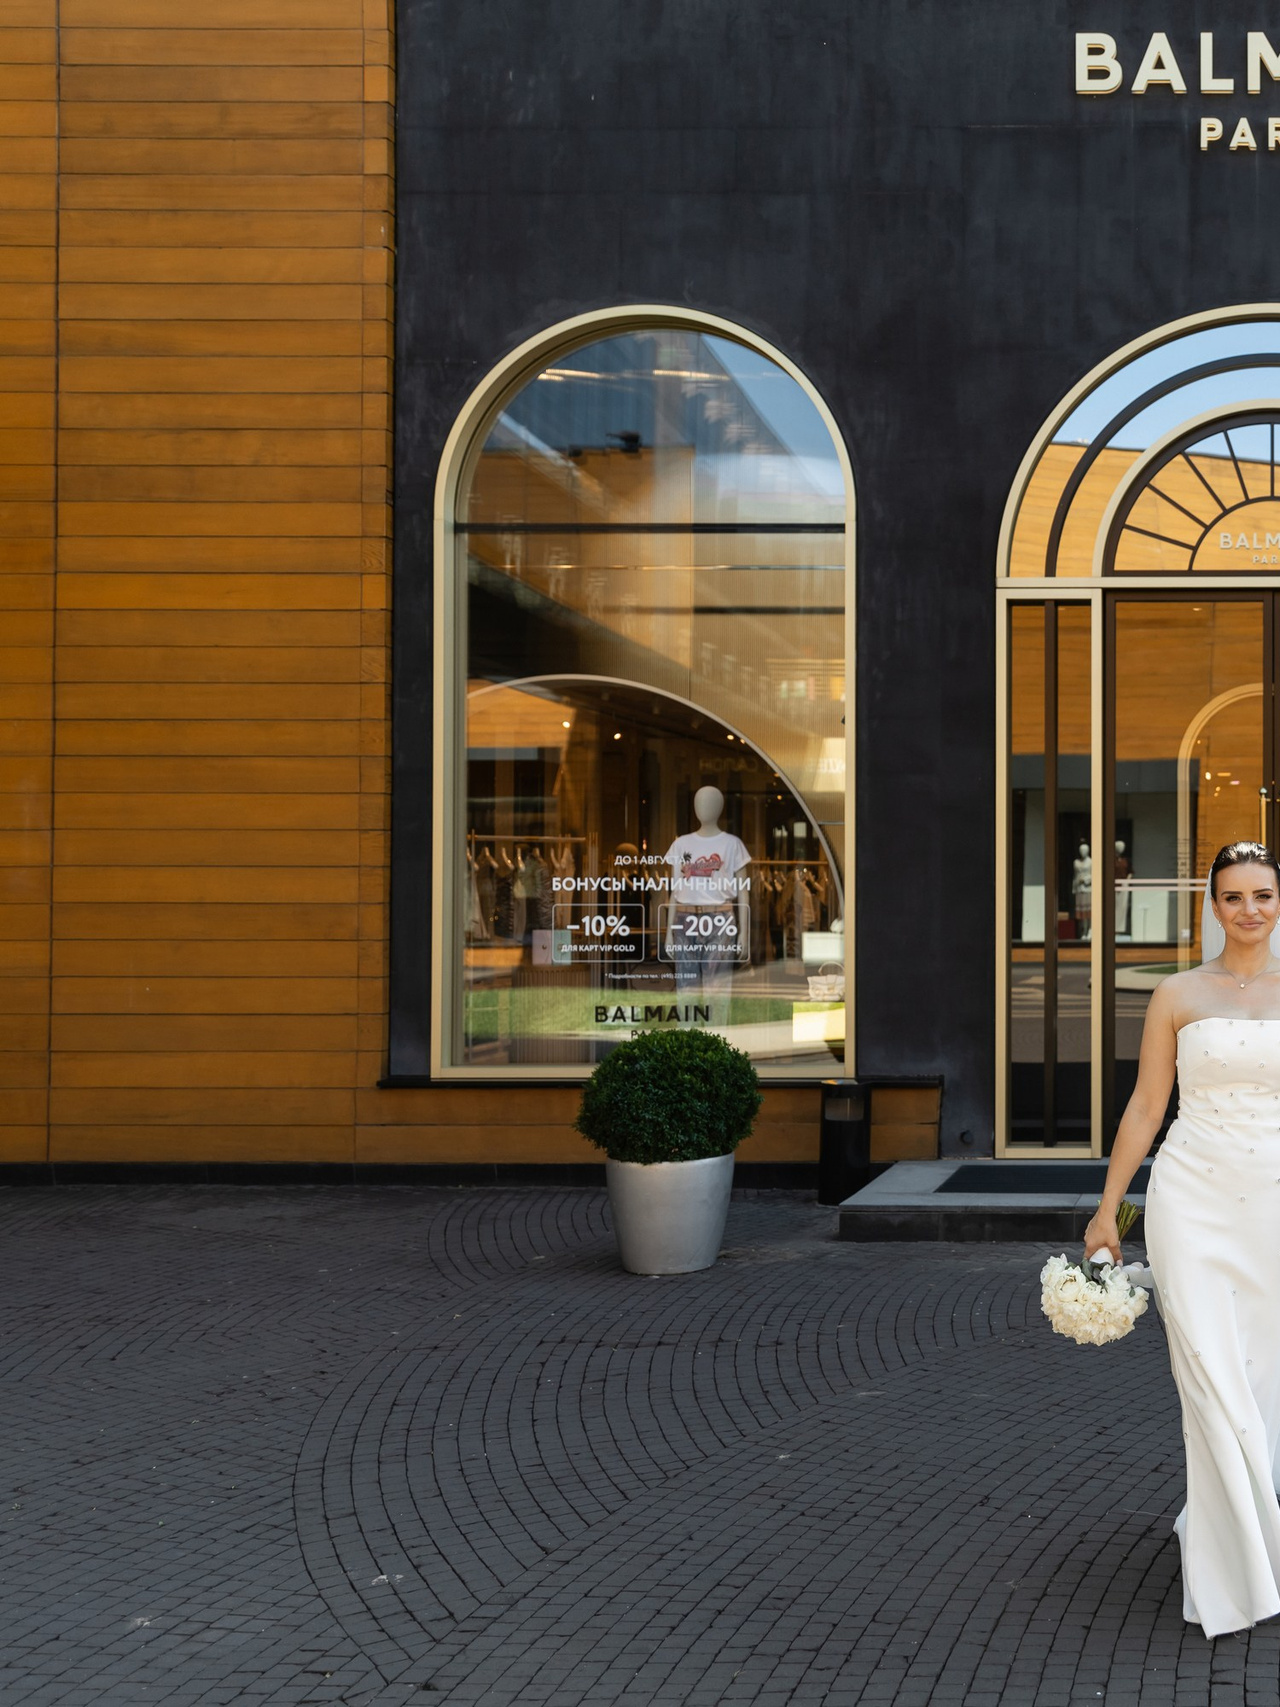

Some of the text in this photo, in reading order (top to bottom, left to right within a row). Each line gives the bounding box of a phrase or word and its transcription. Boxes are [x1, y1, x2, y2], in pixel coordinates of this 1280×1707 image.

[614, 855, 687, 866] ДО 1 АВГУСТА
[552, 877, 751, 891] БОНУСЫ НАЛИЧНЫМИ
[665, 944, 682, 952] ДЛЯ
[594, 1005, 710, 1022] BALMAIN
